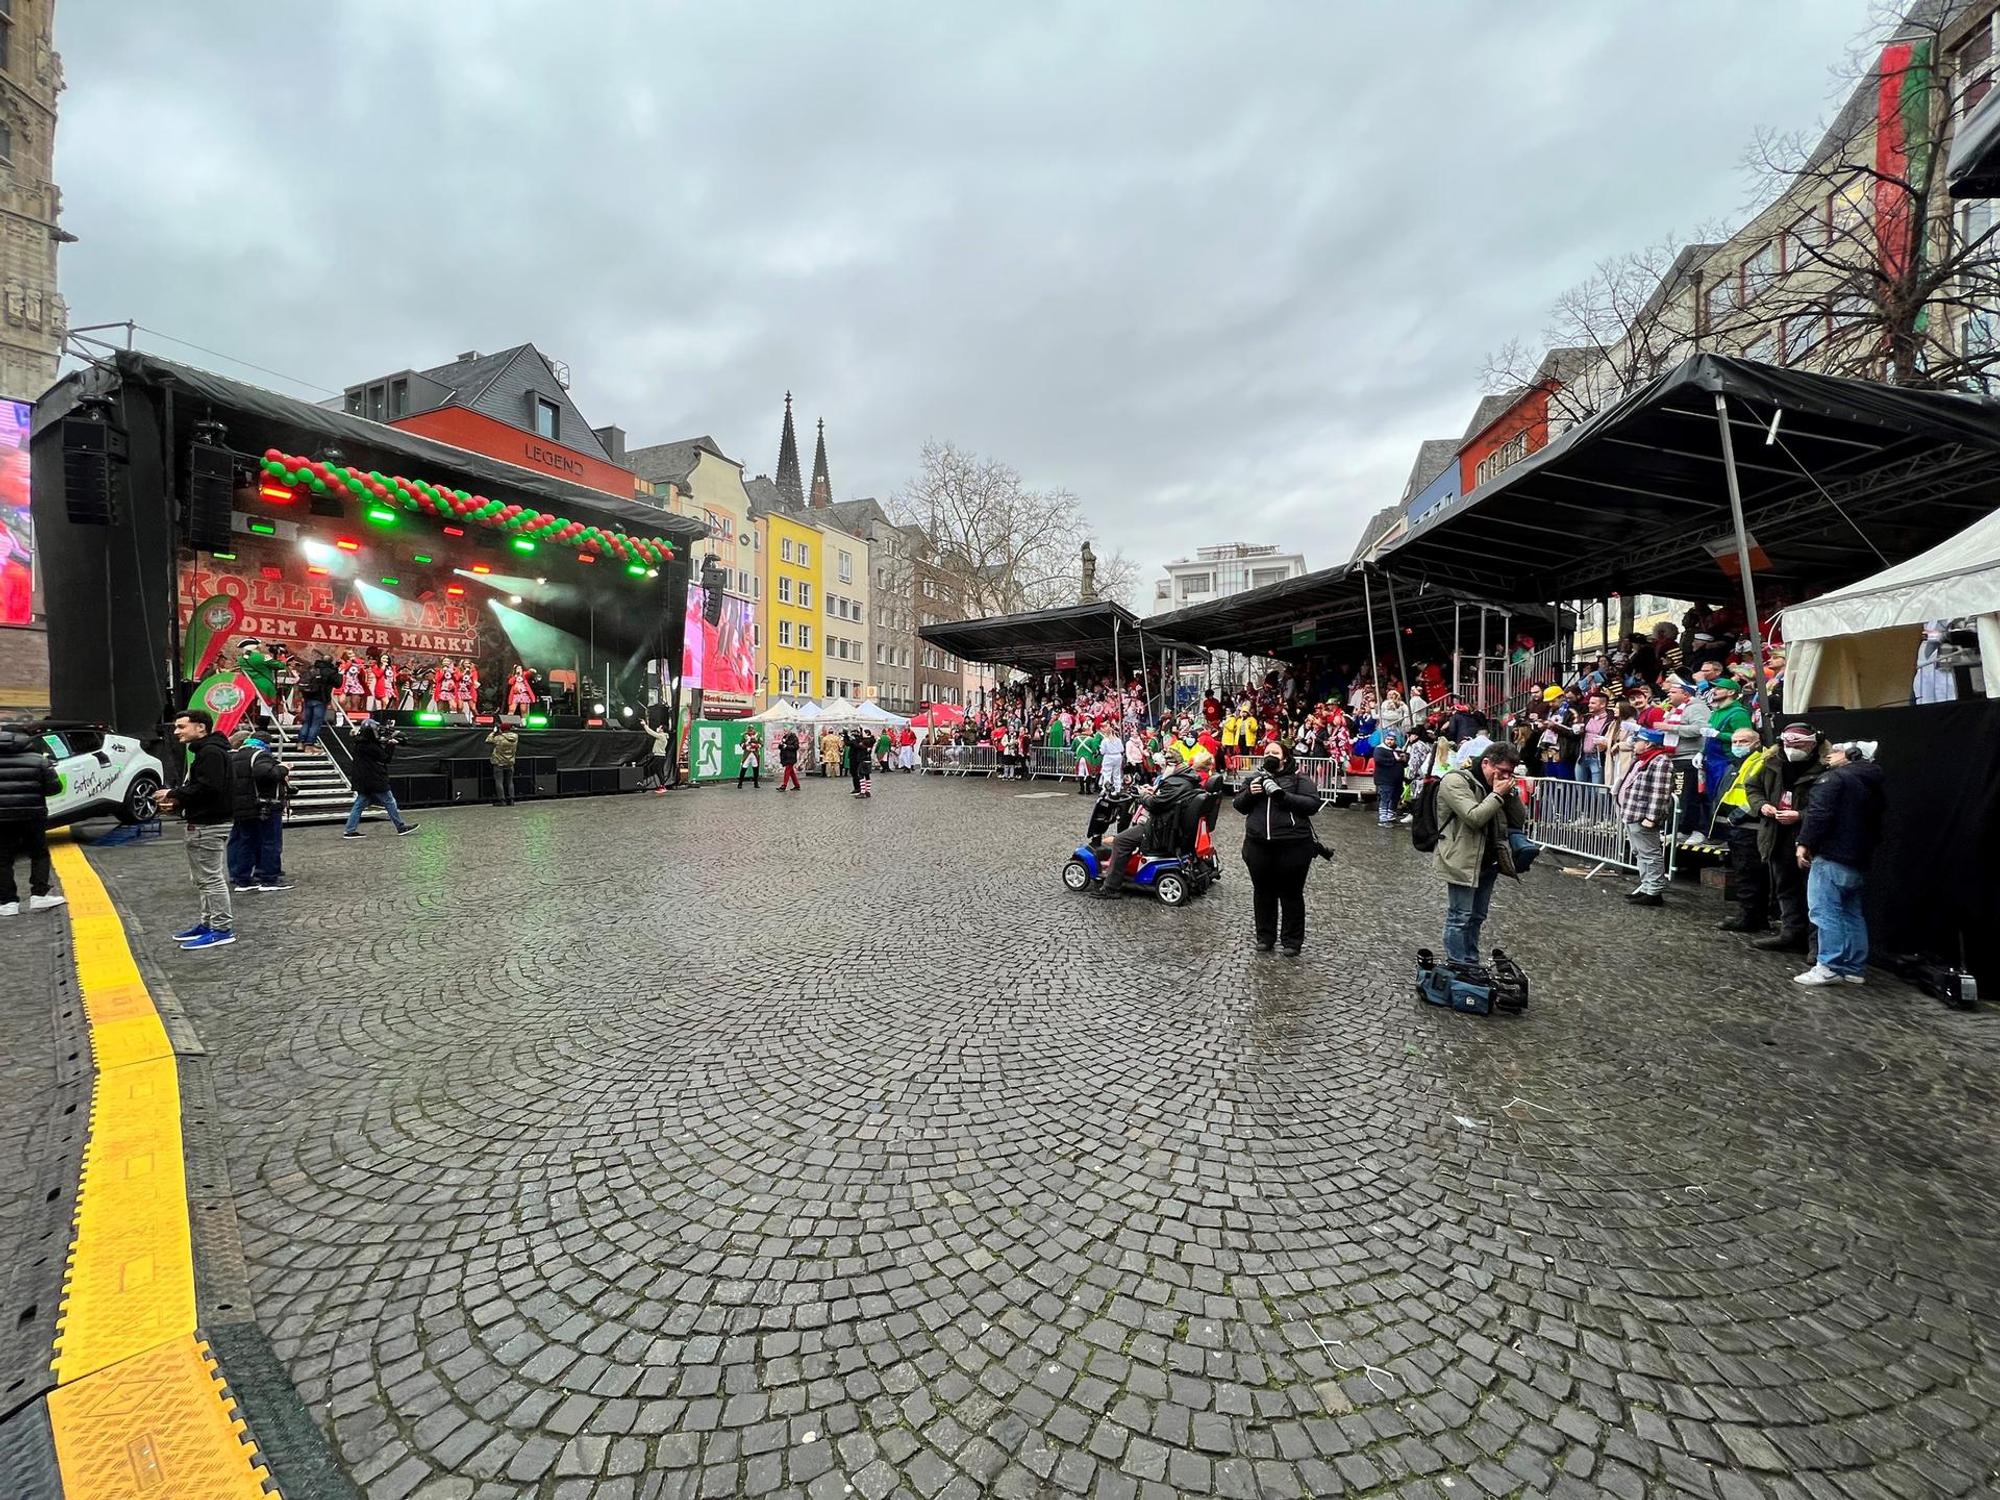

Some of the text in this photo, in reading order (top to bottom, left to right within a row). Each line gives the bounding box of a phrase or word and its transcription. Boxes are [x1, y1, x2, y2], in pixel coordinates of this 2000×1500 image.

[524, 443, 584, 477] LEGEND
[239, 616, 298, 637] DEM
[311, 623, 390, 646] ALTER
[401, 632, 475, 653] MARKT
